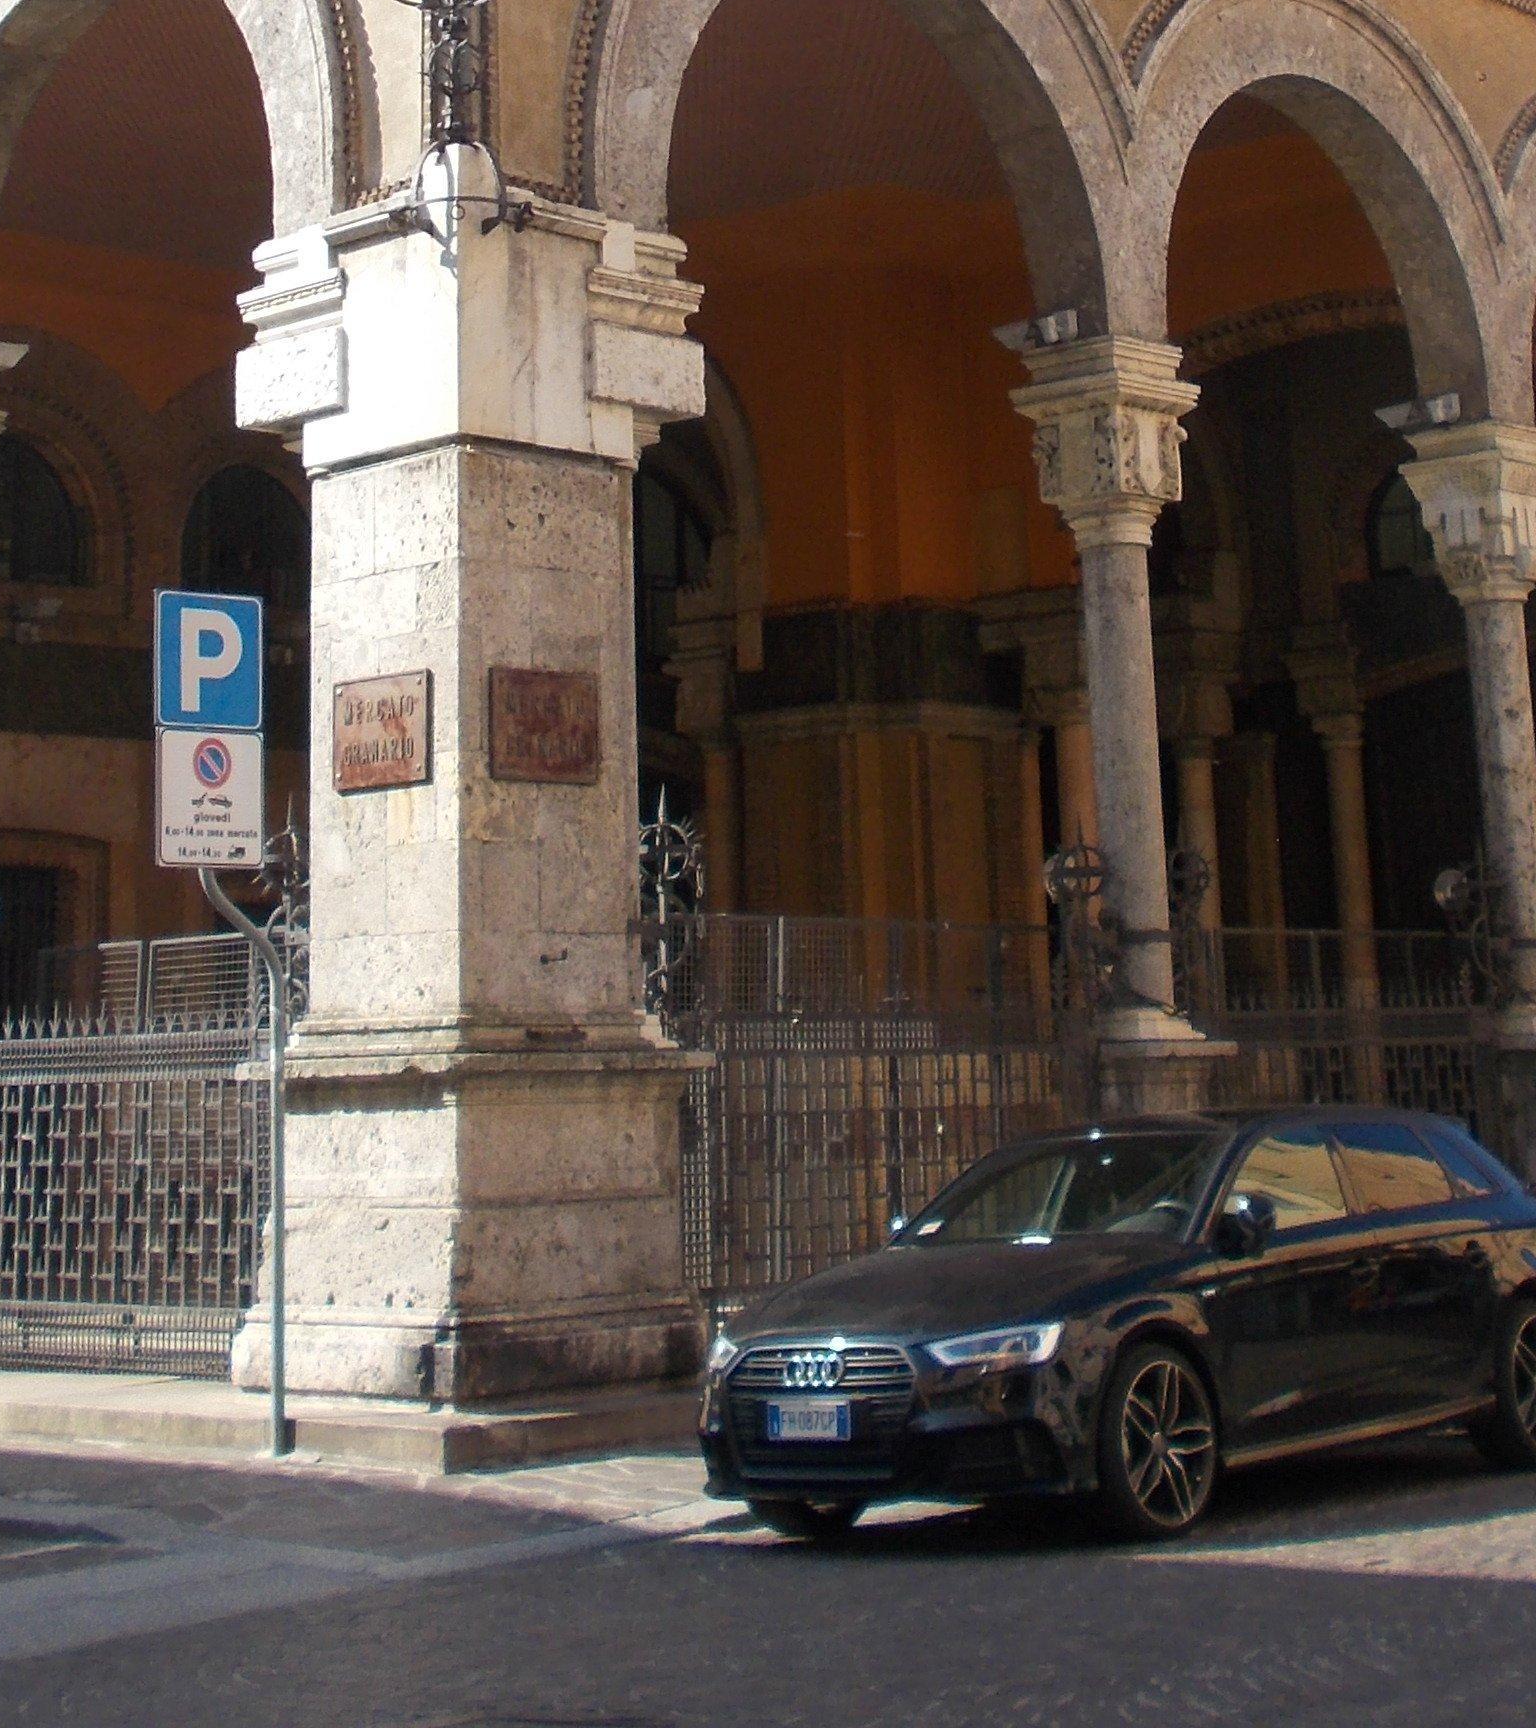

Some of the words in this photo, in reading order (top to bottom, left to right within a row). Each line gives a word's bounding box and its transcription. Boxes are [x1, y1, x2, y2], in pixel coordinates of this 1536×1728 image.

[180, 606, 243, 712] P
[343, 694, 414, 726] MERCATO
[343, 736, 414, 766] GRANARIO
